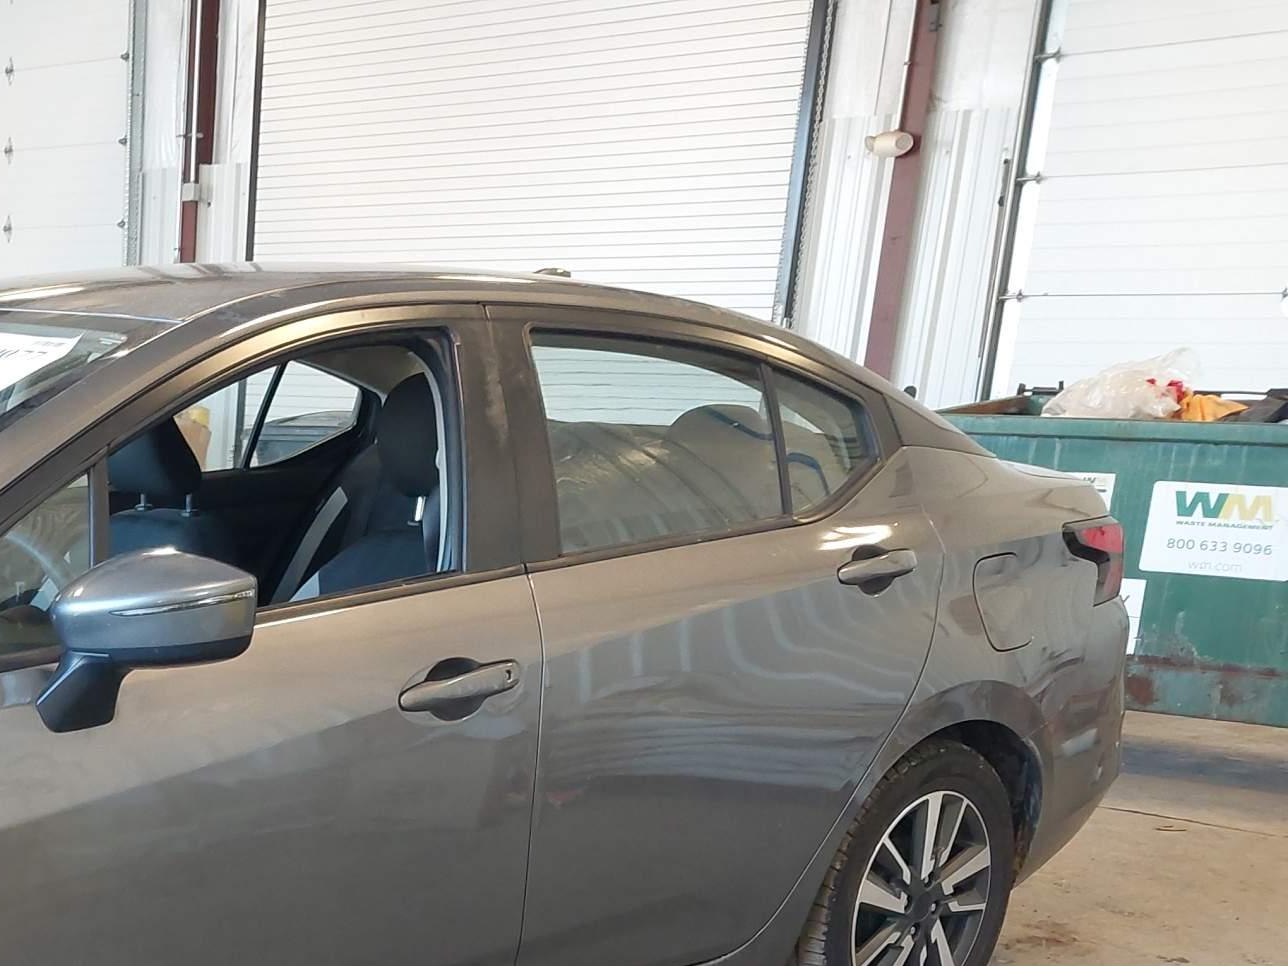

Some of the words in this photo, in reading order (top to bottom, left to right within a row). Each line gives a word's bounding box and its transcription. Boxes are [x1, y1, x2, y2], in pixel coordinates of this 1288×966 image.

[1175, 491, 1273, 522] WM
[1208, 522, 1273, 530] MANAGEMENT
[1166, 538, 1195, 550] 800
[1199, 540, 1228, 552] 633
[1233, 542, 1273, 556] 9096
